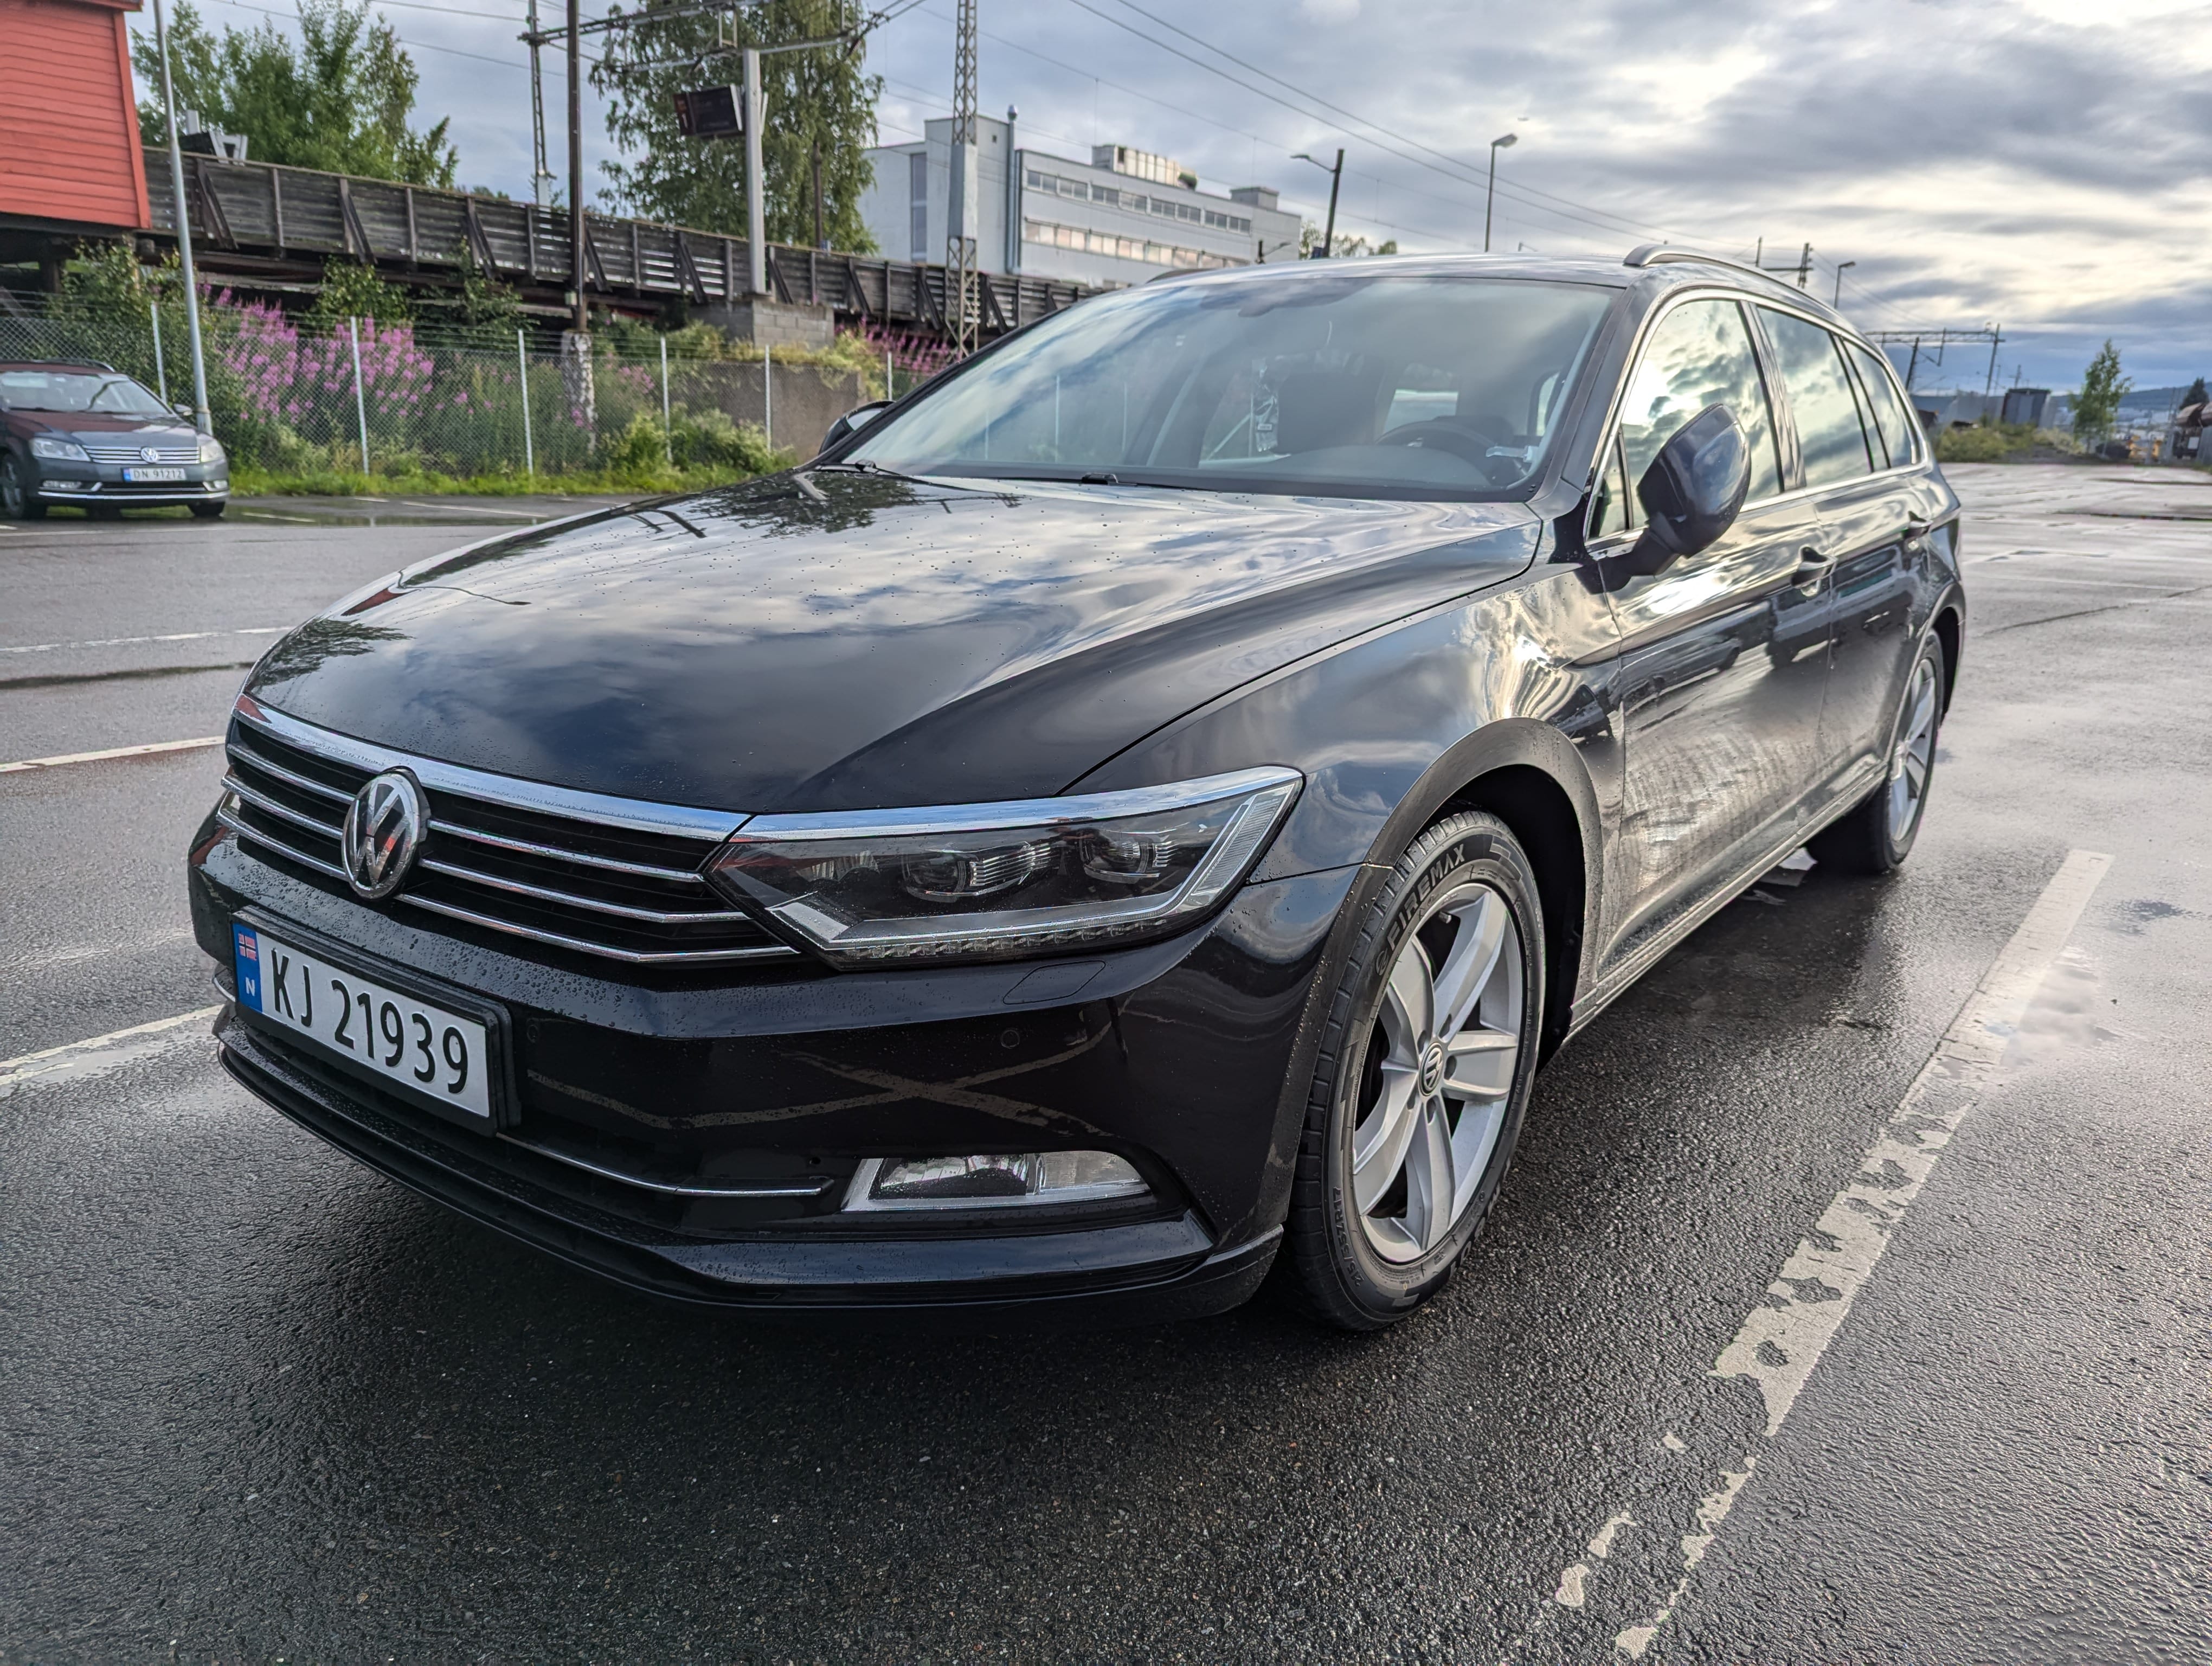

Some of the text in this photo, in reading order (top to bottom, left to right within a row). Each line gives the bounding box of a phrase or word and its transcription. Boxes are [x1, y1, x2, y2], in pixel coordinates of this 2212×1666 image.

[133, 470, 182, 478] DN 91212
[1387, 843, 1465, 951] FIREMAX
[246, 977, 256, 997] N
[271, 949, 468, 1094] KJ 21939
